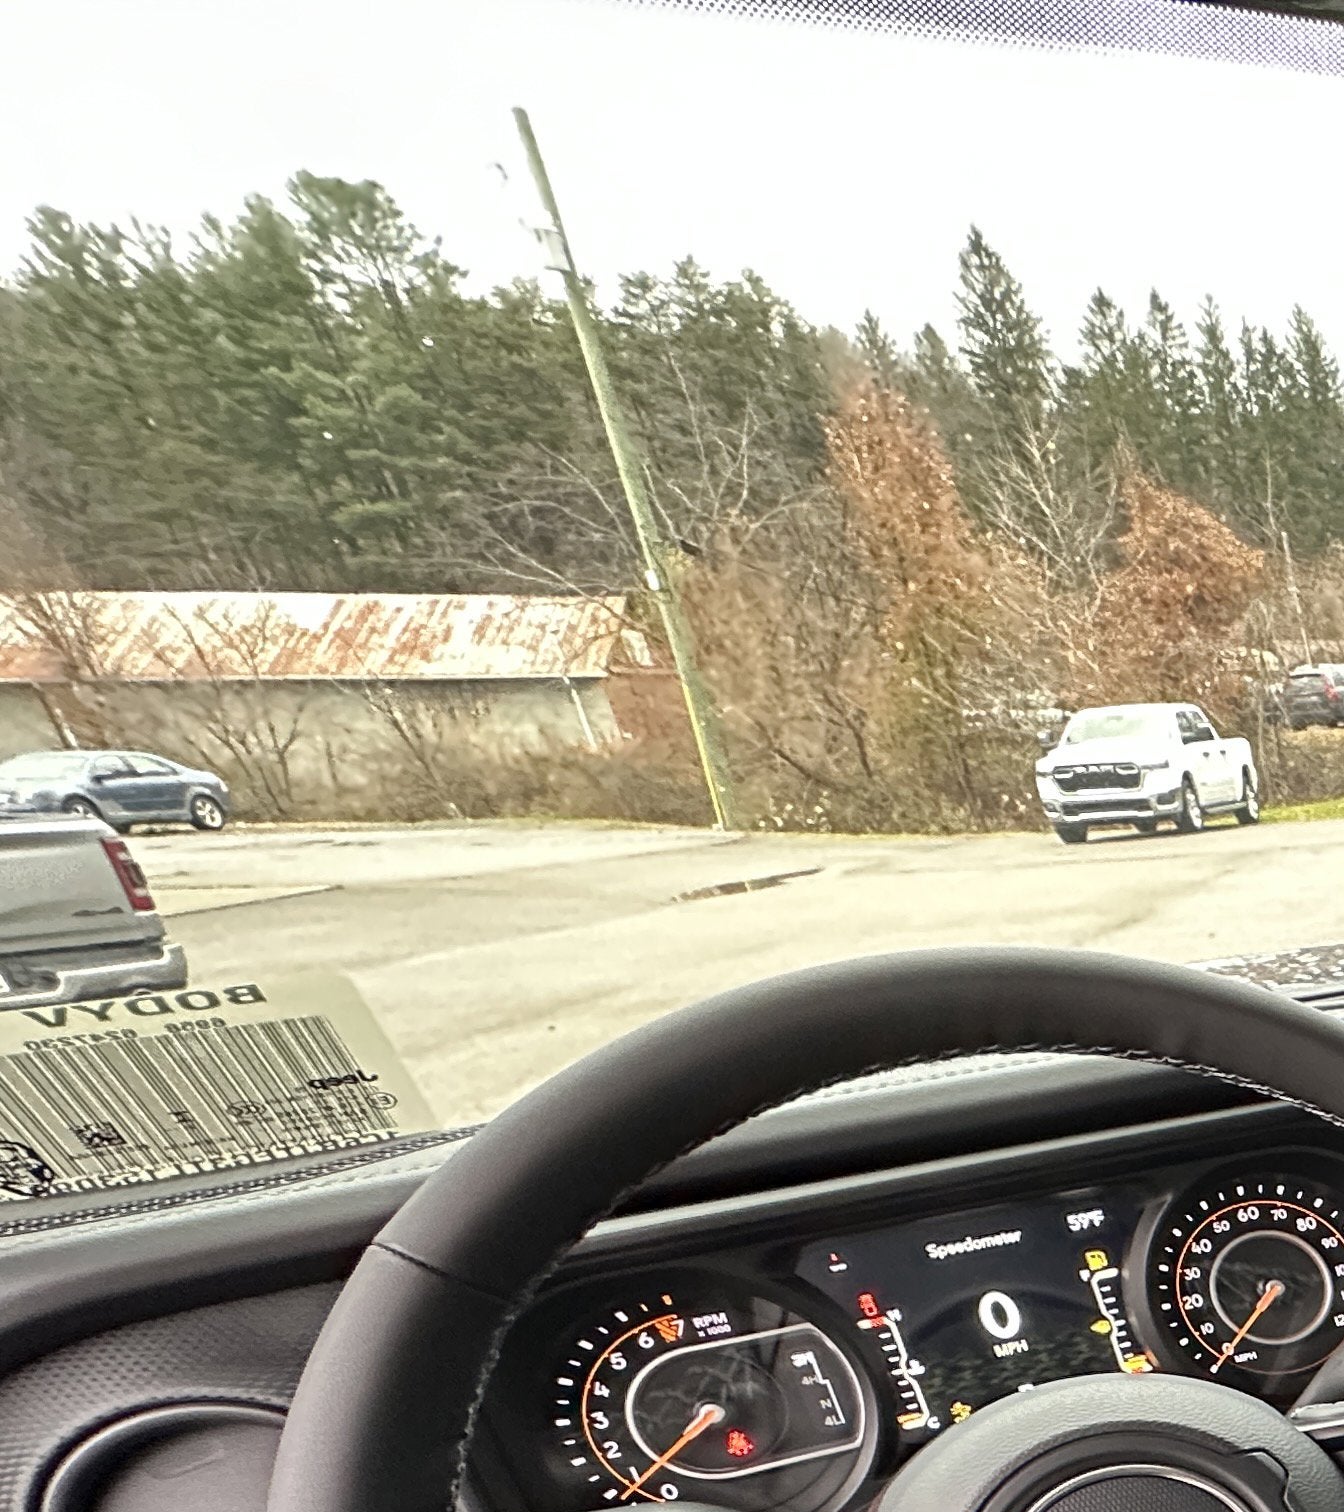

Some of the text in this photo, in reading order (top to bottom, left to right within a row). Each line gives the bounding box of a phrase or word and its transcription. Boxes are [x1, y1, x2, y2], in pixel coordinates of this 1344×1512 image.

[1236, 1206, 1260, 1222] 60
[1270, 1209, 1288, 1221] 70
[1213, 1220, 1231, 1233] 50
[1296, 1216, 1317, 1231] 80
[925, 1230, 1022, 1260] Speedometer
[1191, 1238, 1212, 1254] 40
[1321, 1236, 1339, 1249] 90
[1183, 1267, 1201, 1280] 30
[1182, 1294, 1203, 1309] 20
[692, 1312, 728, 1329] RPM
[978, 1289, 1022, 1340] 0
[1200, 1322, 1214, 1335] 10
[638, 1332, 654, 1349] 6
[993, 1339, 1029, 1358] MPH
[609, 1352, 627, 1370] 5
[593, 1382, 610, 1398] 4
[592, 1412, 609, 1429] 3
[604, 1442, 622, 1459] 2
[660, 1484, 678, 1501] 0
